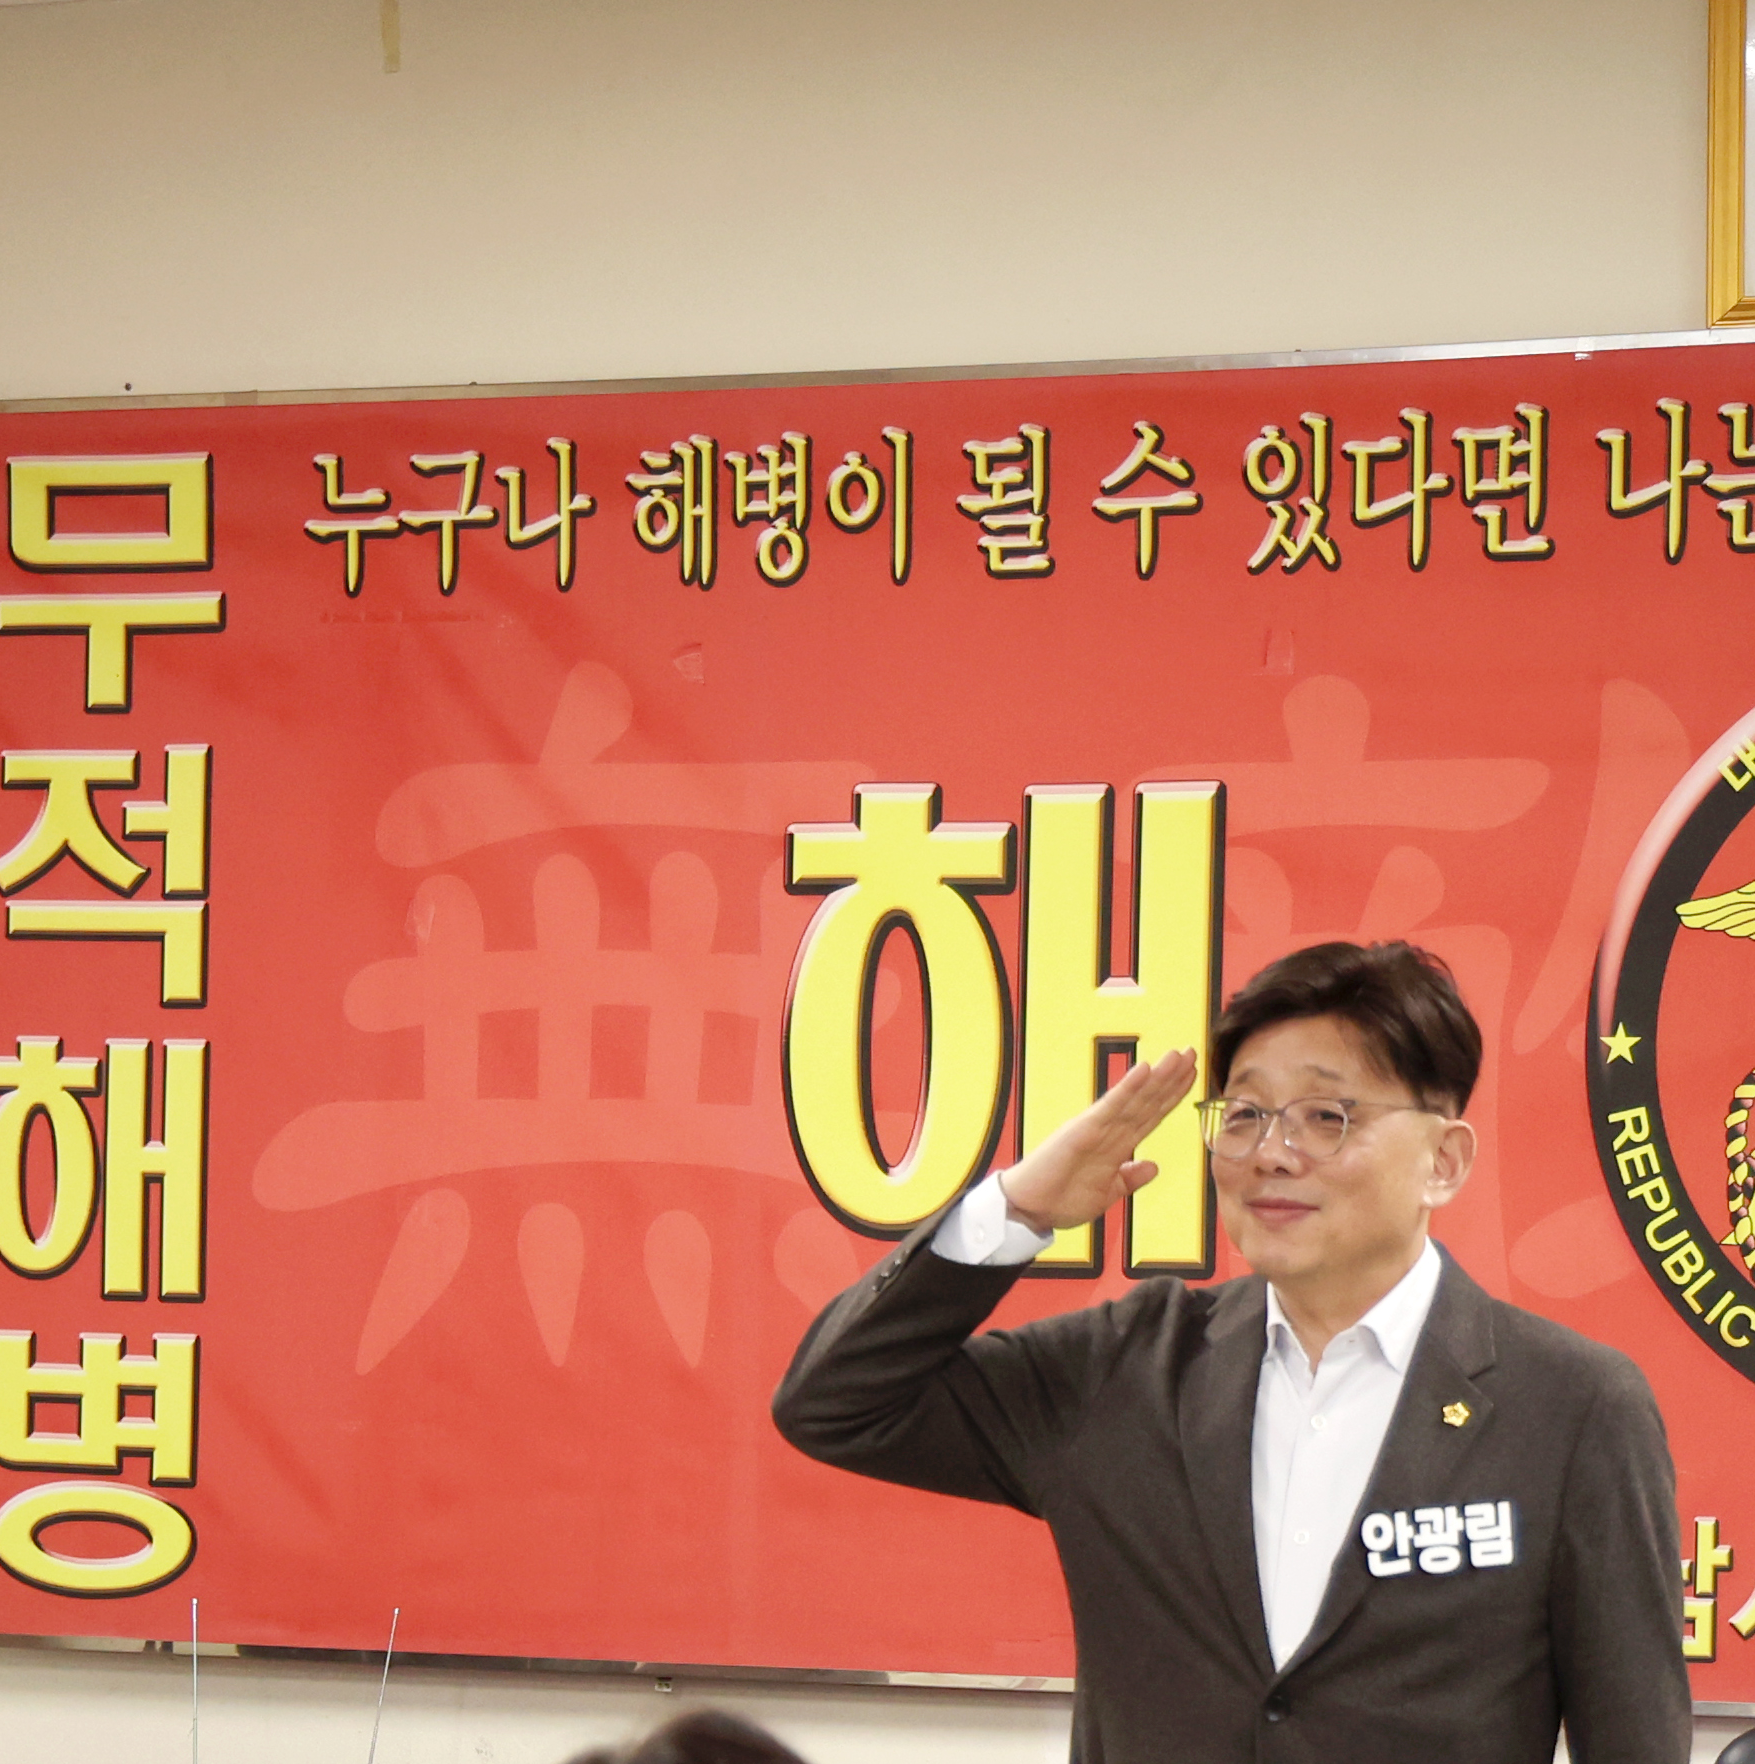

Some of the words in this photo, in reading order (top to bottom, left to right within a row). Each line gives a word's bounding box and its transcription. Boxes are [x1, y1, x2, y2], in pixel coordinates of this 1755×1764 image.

[304, 438, 595, 596] 누구나
[626, 427, 914, 588] 해병이
[956, 423, 1054, 577] 될
[1093, 420, 1202, 578] 수
[1243, 404, 1553, 575] 있다면
[1360, 1500, 1514, 1578] 안광림
